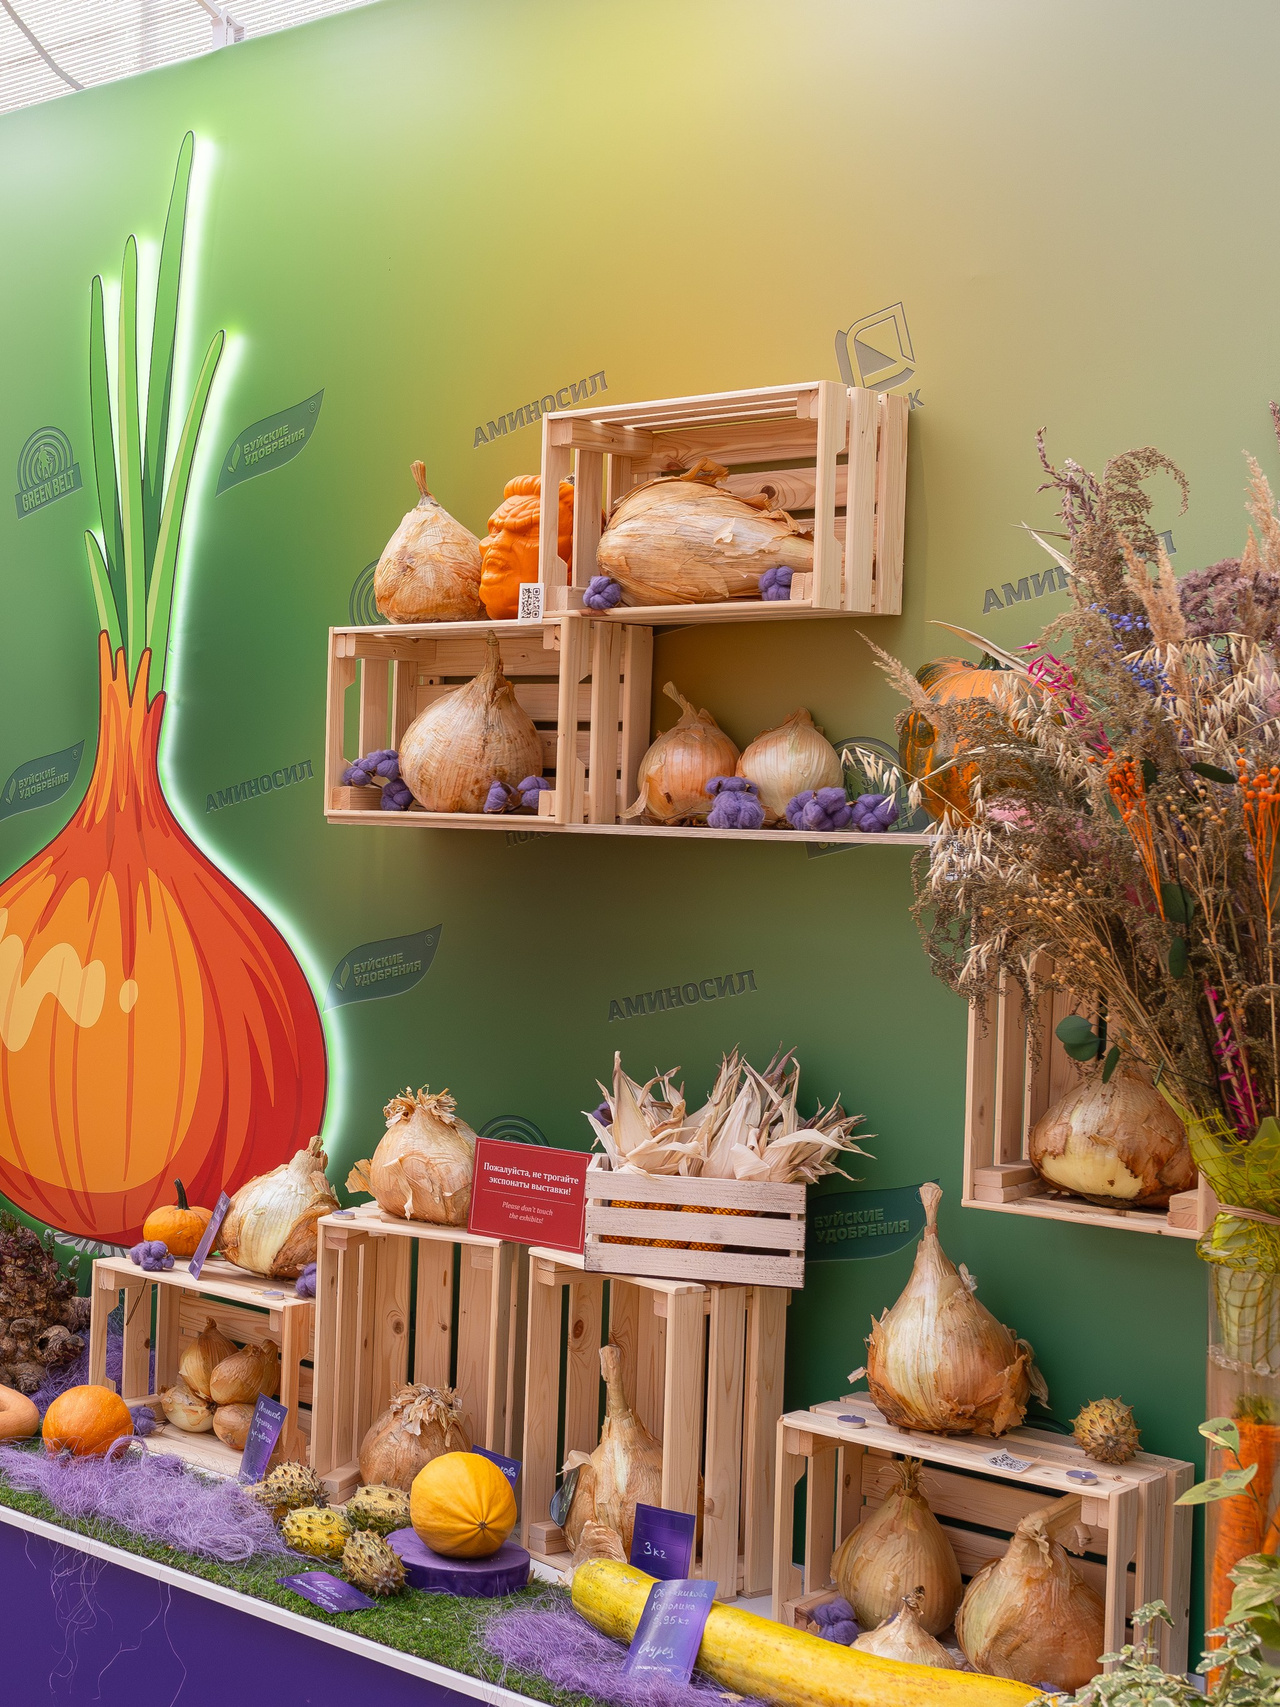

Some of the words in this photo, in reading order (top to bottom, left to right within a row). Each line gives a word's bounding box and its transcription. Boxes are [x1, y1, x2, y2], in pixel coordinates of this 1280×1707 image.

[473, 370, 608, 449] АМИНОСИЛ
[243, 424, 289, 454] БУЙСКИЕ
[244, 428, 305, 466] УДОБРЕНИЯ
[22, 481, 52, 512] GREEN
[52, 470, 74, 498] BELT
[18, 767, 56, 789] БУЙСКИЕ
[19, 772, 69, 799] УДОБРЕНИЯ
[205, 760, 314, 814] АМИНОСИЛ
[353, 952, 404, 975] БУЙСКИЕ
[355, 960, 421, 986] УДОБРЕНИЯ
[608, 969, 758, 1023] АМИНОСИЛ
[483, 1162, 531, 1178] Пожалуйста,
[532, 1171, 542, 1179] не
[543, 1172, 579, 1185] трогайте
[489, 1176, 530, 1189] экспонаты
[531, 1183, 572, 1196] выставки!
[502, 1201, 521, 1211] Please
[537, 1207, 553, 1216] touch
[509, 1212, 519, 1220] the
[519, 1215, 544, 1225] exhibits!
[814, 1207, 885, 1229] БУЙСКИЕ
[816, 1219, 910, 1244] УДОБРЕНИЯ
